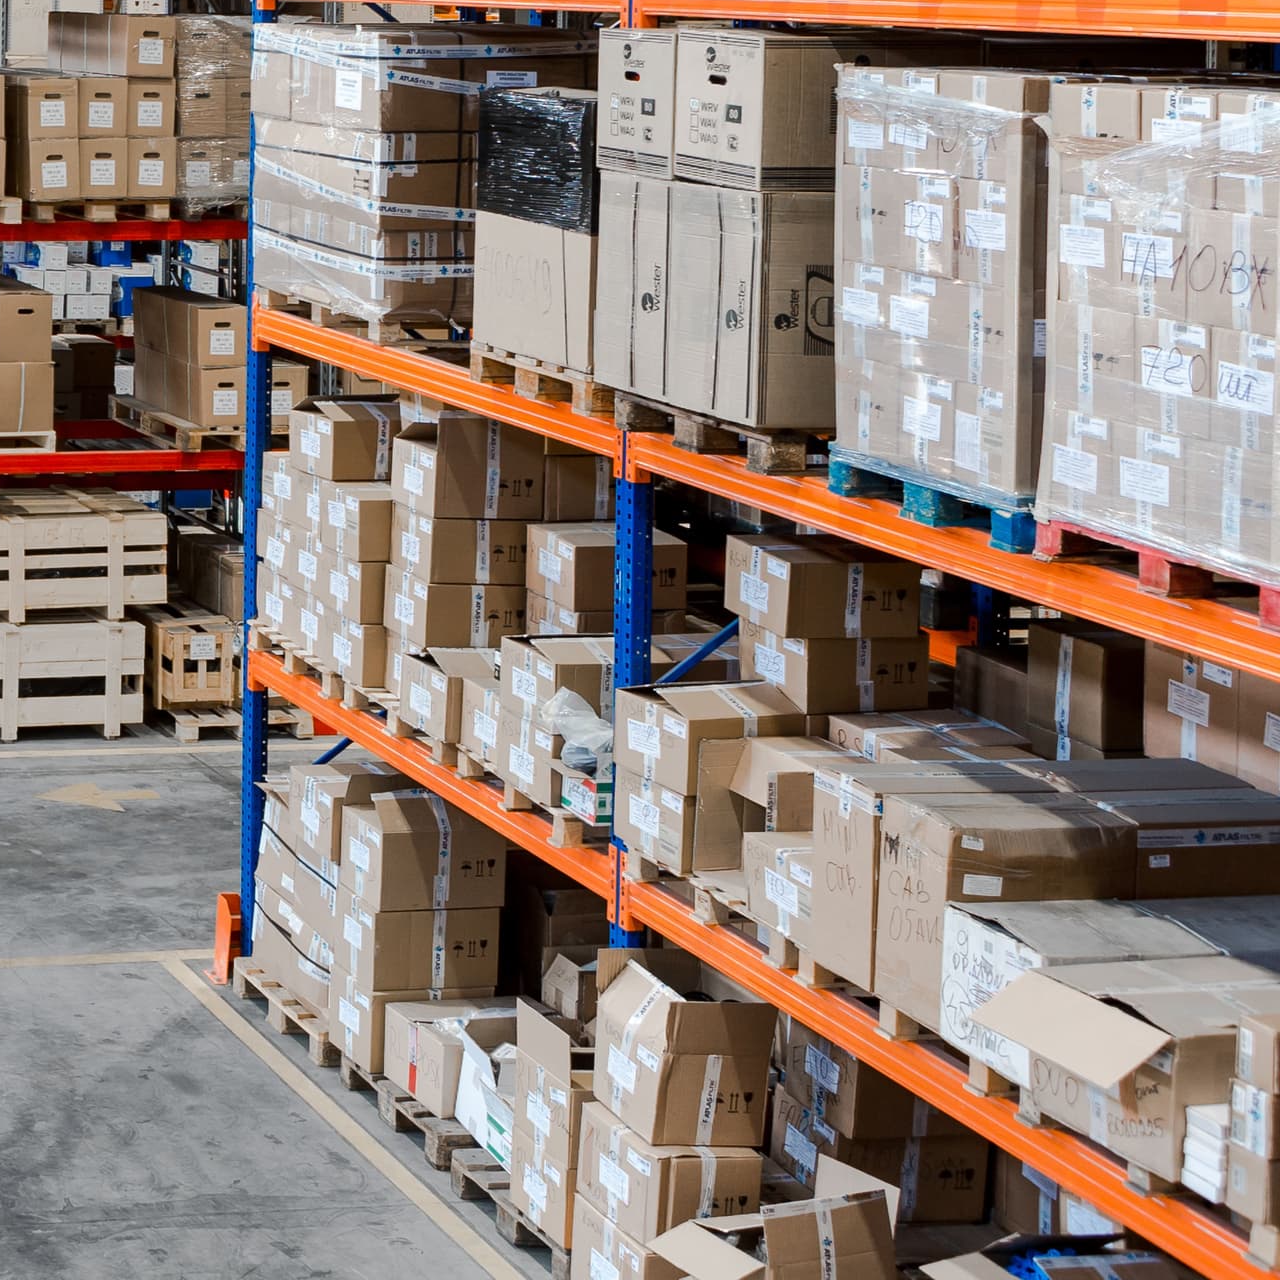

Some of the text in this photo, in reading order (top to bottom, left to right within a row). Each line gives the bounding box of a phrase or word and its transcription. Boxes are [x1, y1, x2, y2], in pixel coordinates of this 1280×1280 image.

[399, 76, 419, 84] ATLAS
[700, 102, 719, 112] WRV
[700, 118, 717, 128] WAV
[653, 264, 662, 312] Wester
[737, 280, 746, 330] Wester
[790, 288, 799, 330] Wester
[1141, 344, 1207, 393] 720
[1212, 833, 1240, 841] ATLAS
[1032, 1057, 1080, 1106] DUO
